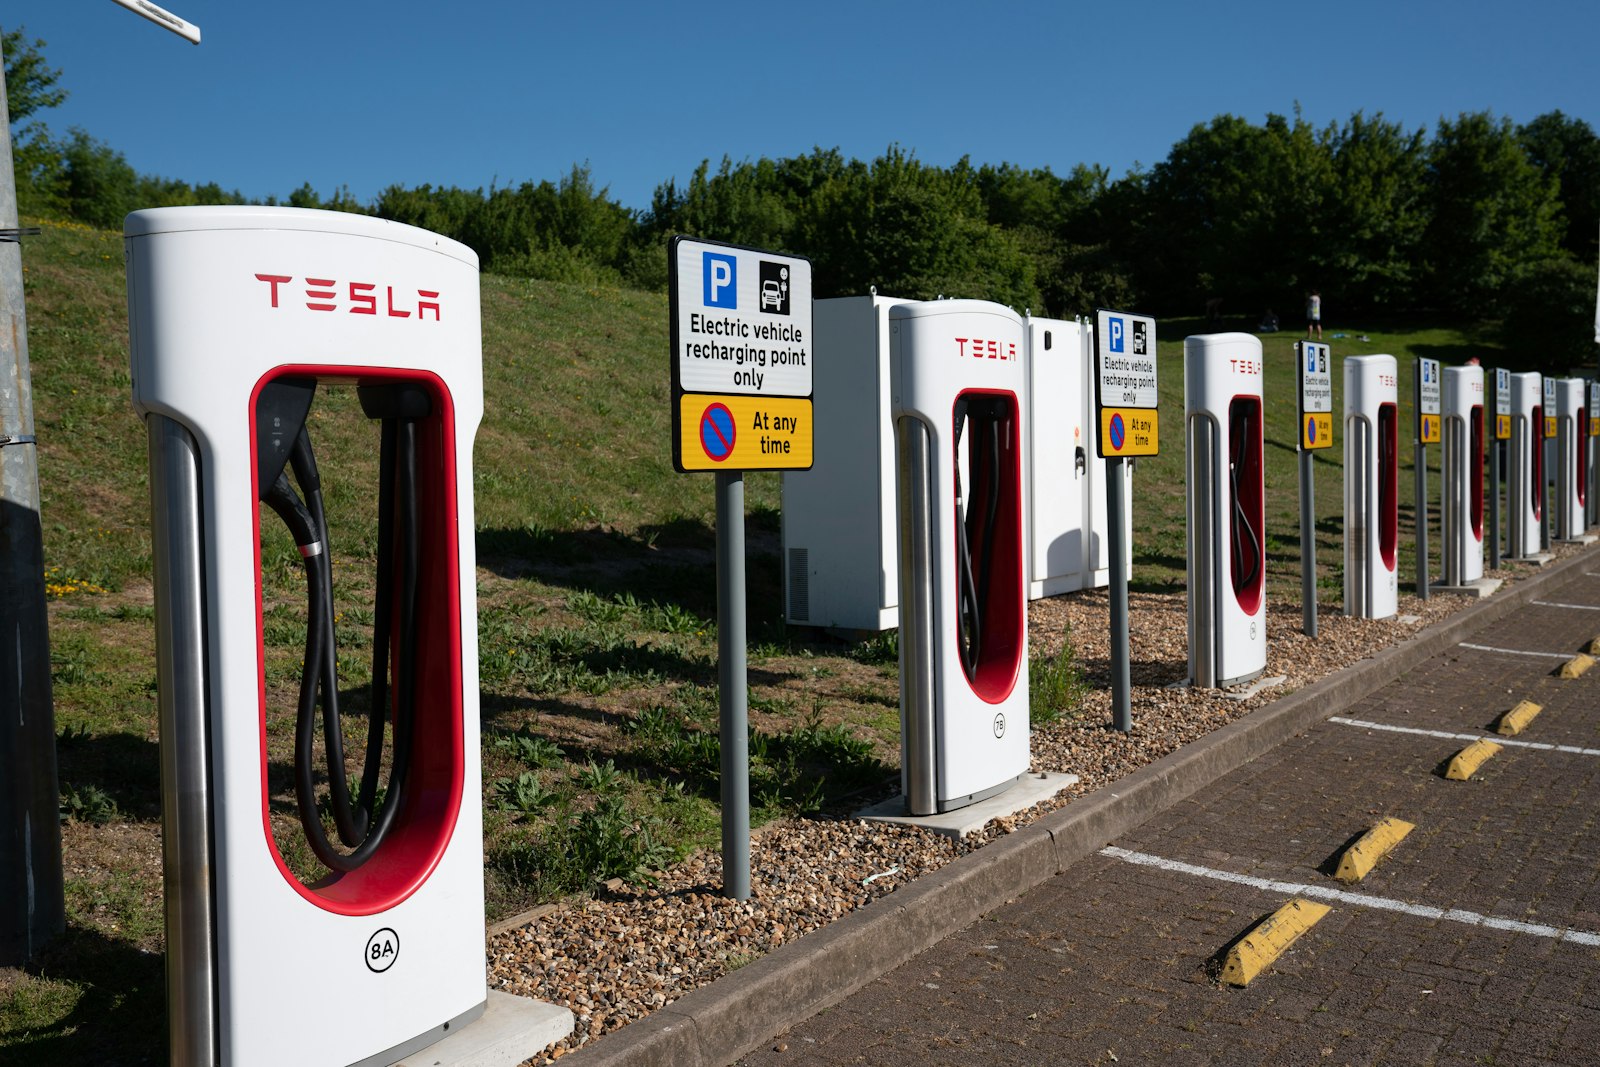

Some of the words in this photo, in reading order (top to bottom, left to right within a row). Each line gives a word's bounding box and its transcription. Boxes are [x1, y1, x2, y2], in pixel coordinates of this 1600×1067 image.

[710, 259, 732, 303] P
[254, 273, 440, 321] TESLA
[690, 313, 749, 338] Electric
[753, 322, 802, 343] vehicle
[1111, 321, 1122, 350] P
[686, 340, 766, 367] recharging
[771, 345, 806, 367] point
[954, 337, 1016, 362] TESLA
[1104, 356, 1129, 371] Electric
[1131, 359, 1152, 373] vehicle
[1230, 359, 1261, 375] TESLA
[733, 368, 764, 390] only
[1103, 374, 1138, 389] recharging
[1138, 376, 1155, 389] point
[1379, 375, 1397, 387] TES
[1122, 390, 1137, 405] only
[753, 411, 769, 430] At
[773, 415, 797, 434] any
[1131, 417, 1140, 431] At
[1140, 420, 1152, 433] any
[760, 436, 790, 454] time
[1134, 434, 1149, 446] time
[995, 720, 1004, 731] 7B
[371, 939, 394, 960] 8A
